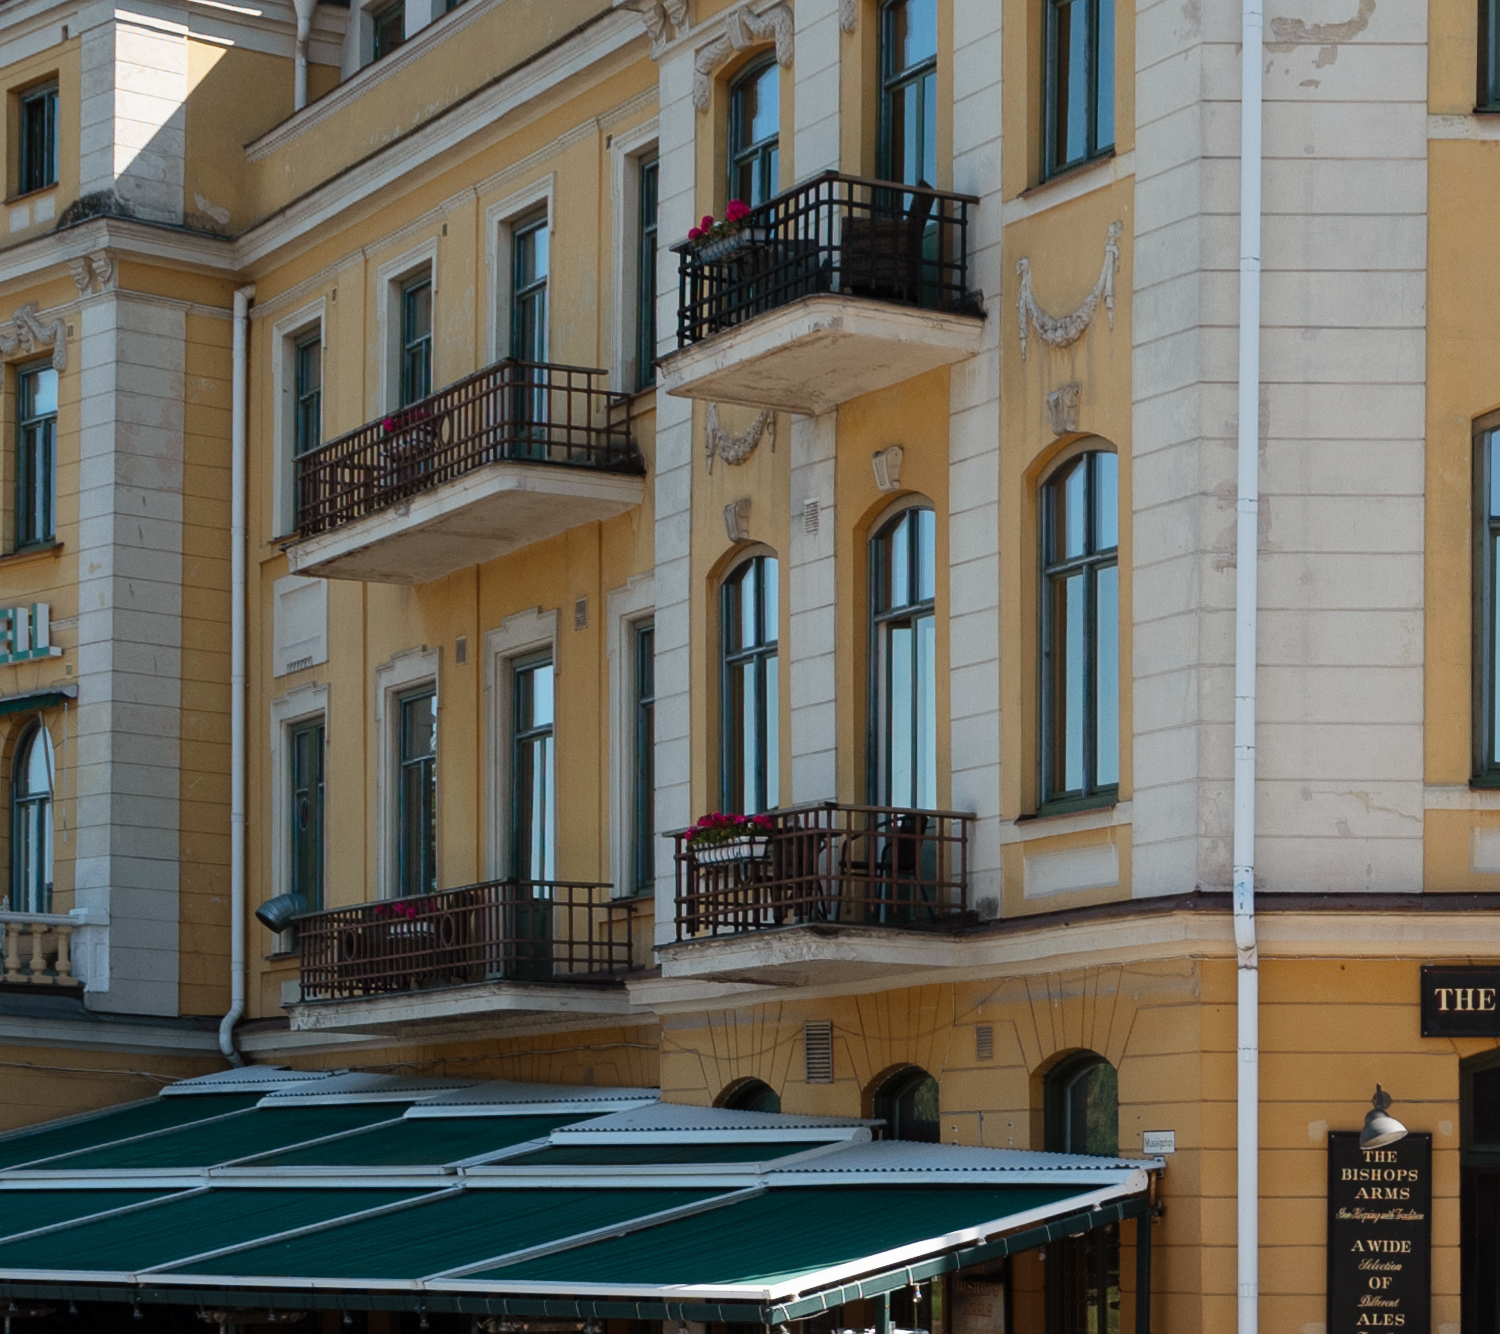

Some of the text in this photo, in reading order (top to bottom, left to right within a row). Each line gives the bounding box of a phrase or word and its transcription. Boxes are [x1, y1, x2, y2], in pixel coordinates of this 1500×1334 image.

[1434, 987, 1496, 1011] THE
[1363, 1150, 1397, 1163] THE
[1341, 1168, 1418, 1182] BISHOPS
[1354, 1187, 1410, 1200] ARMS
[1350, 1239, 1412, 1253] A WIDE
[1358, 1258, 1402, 1271] Selection
[1368, 1276, 1393, 1289] OF
[1356, 1313, 1406, 1326] ALES
